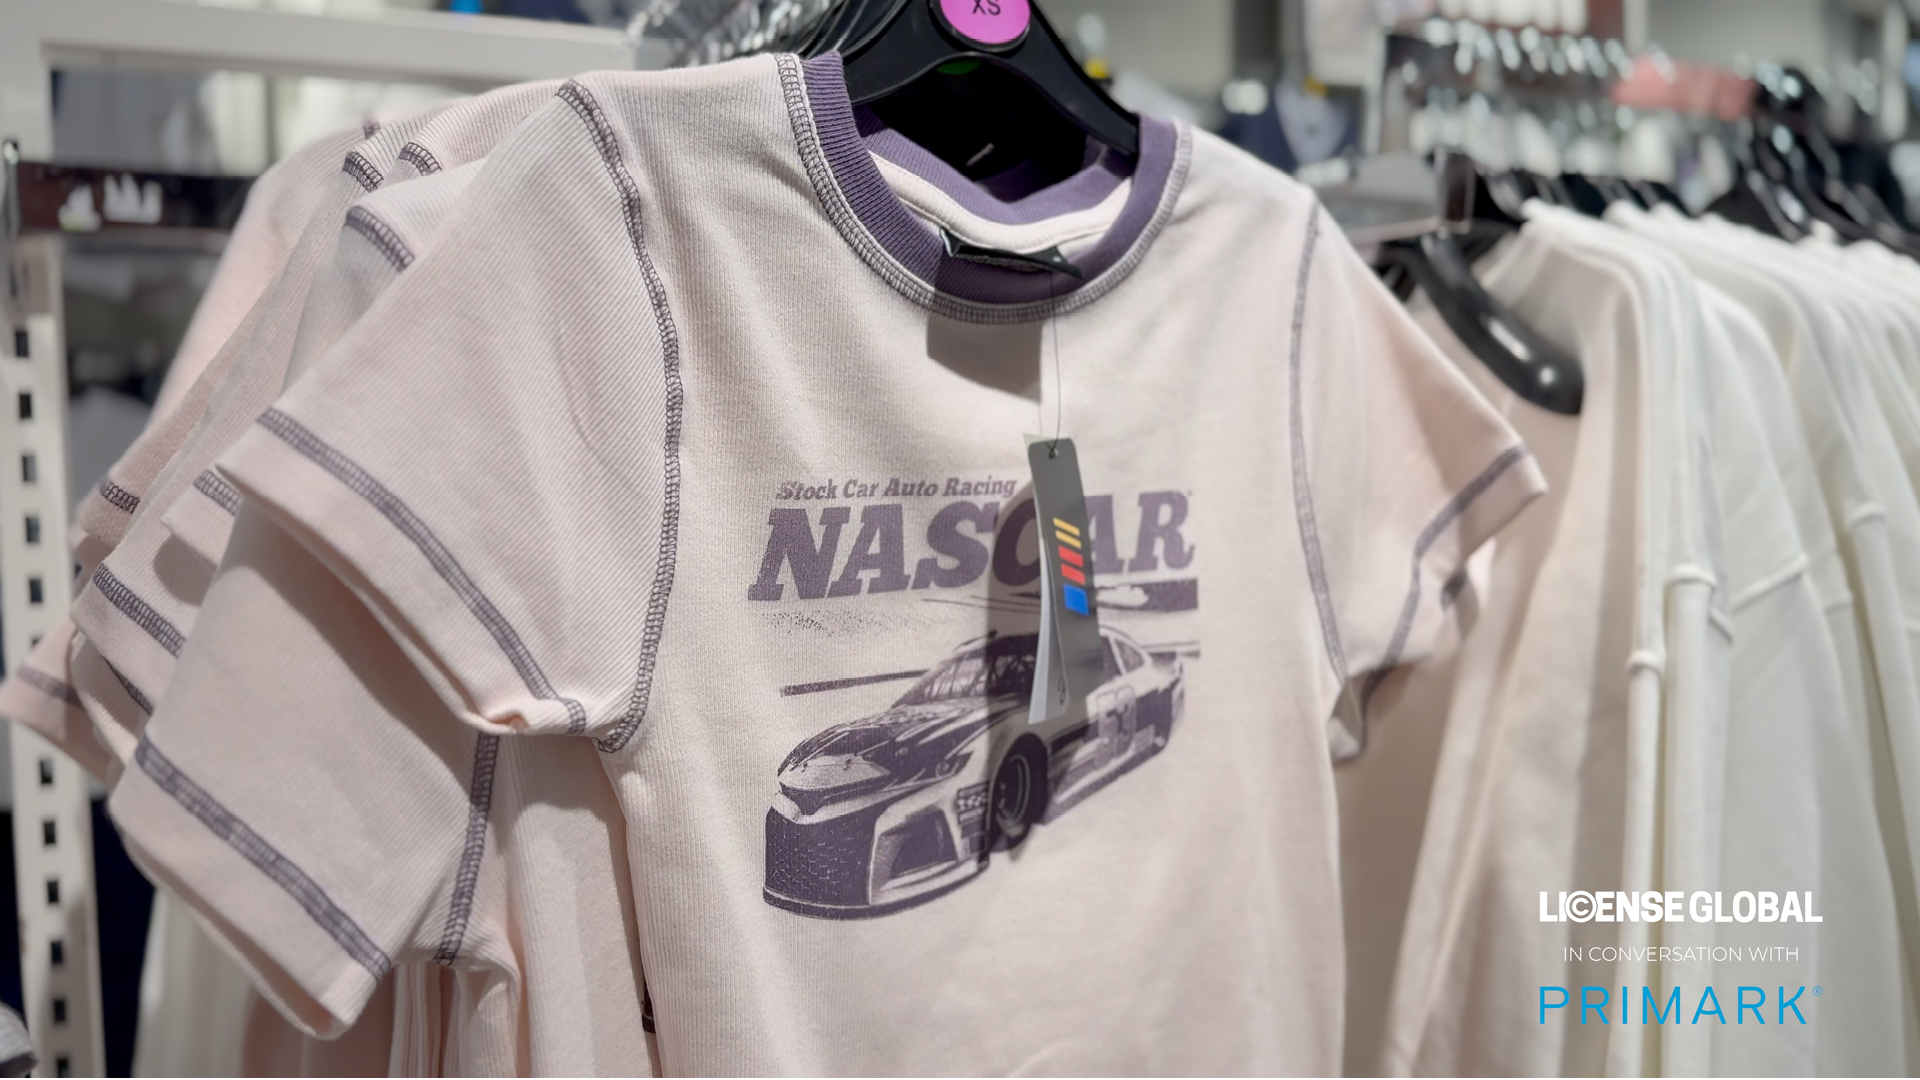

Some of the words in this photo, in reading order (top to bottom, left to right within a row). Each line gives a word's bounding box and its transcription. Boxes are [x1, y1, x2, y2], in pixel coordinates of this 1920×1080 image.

[972, 0, 1001, 16] XS
[777, 479, 838, 500] Stock
[843, 479, 879, 497] Car
[884, 478, 938, 497] Auto
[942, 475, 1017, 497] Racing
